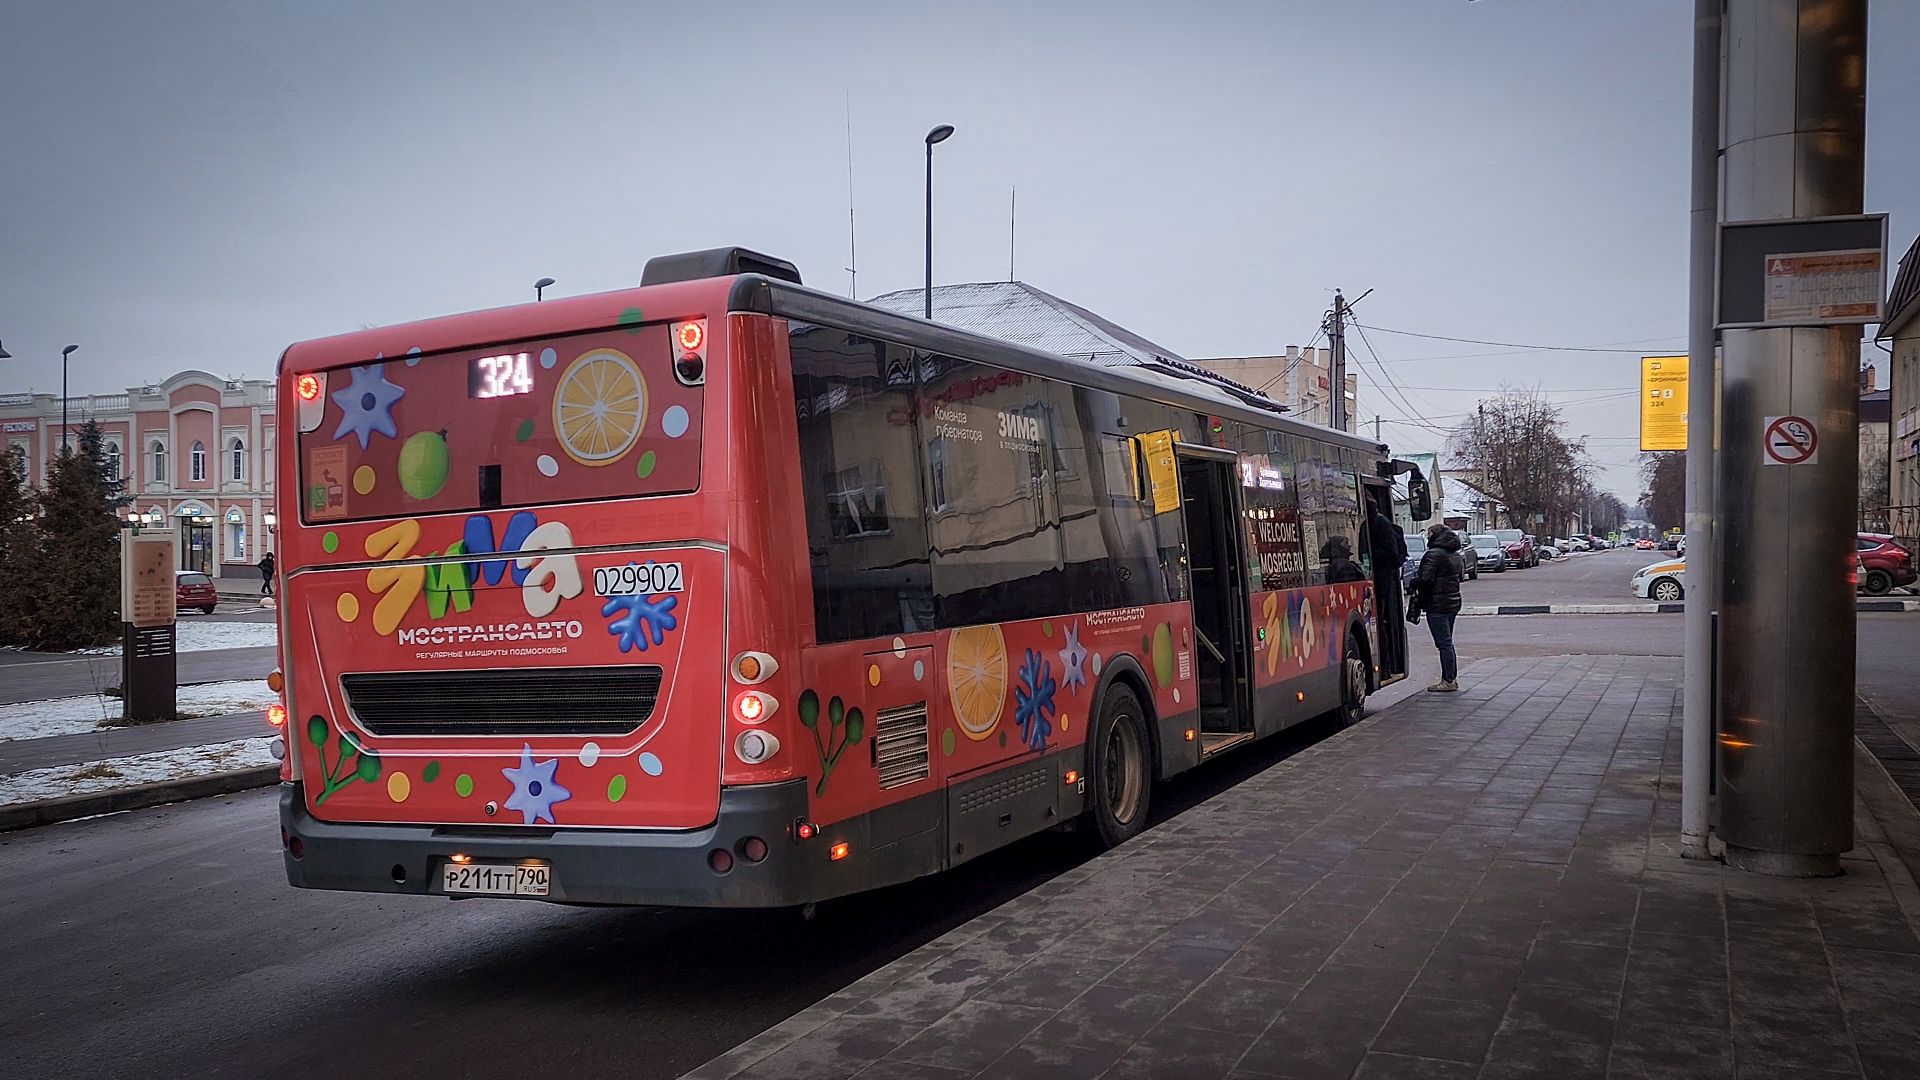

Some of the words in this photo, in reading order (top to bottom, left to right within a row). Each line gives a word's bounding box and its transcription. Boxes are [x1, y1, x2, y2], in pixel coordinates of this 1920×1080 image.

[478, 353, 532, 398] 324
[934, 406, 967, 424] Команда
[936, 424, 983, 444] губернатора
[1260, 551, 1304, 574] MOSREG.RU
[594, 563, 682, 595] 029902
[1086, 607, 1145, 627] МОСТРАНСАВТО
[398, 620, 583, 646] МОСТРАНСАВТО
[415, 650, 463, 659] РЕГУЛЯРНЫЕ
[465, 649, 508, 658] МАРШРУТЫ
[509, 646, 568, 656] ПОДМОСКОВЬЯ
[517, 868, 545, 886] 790
